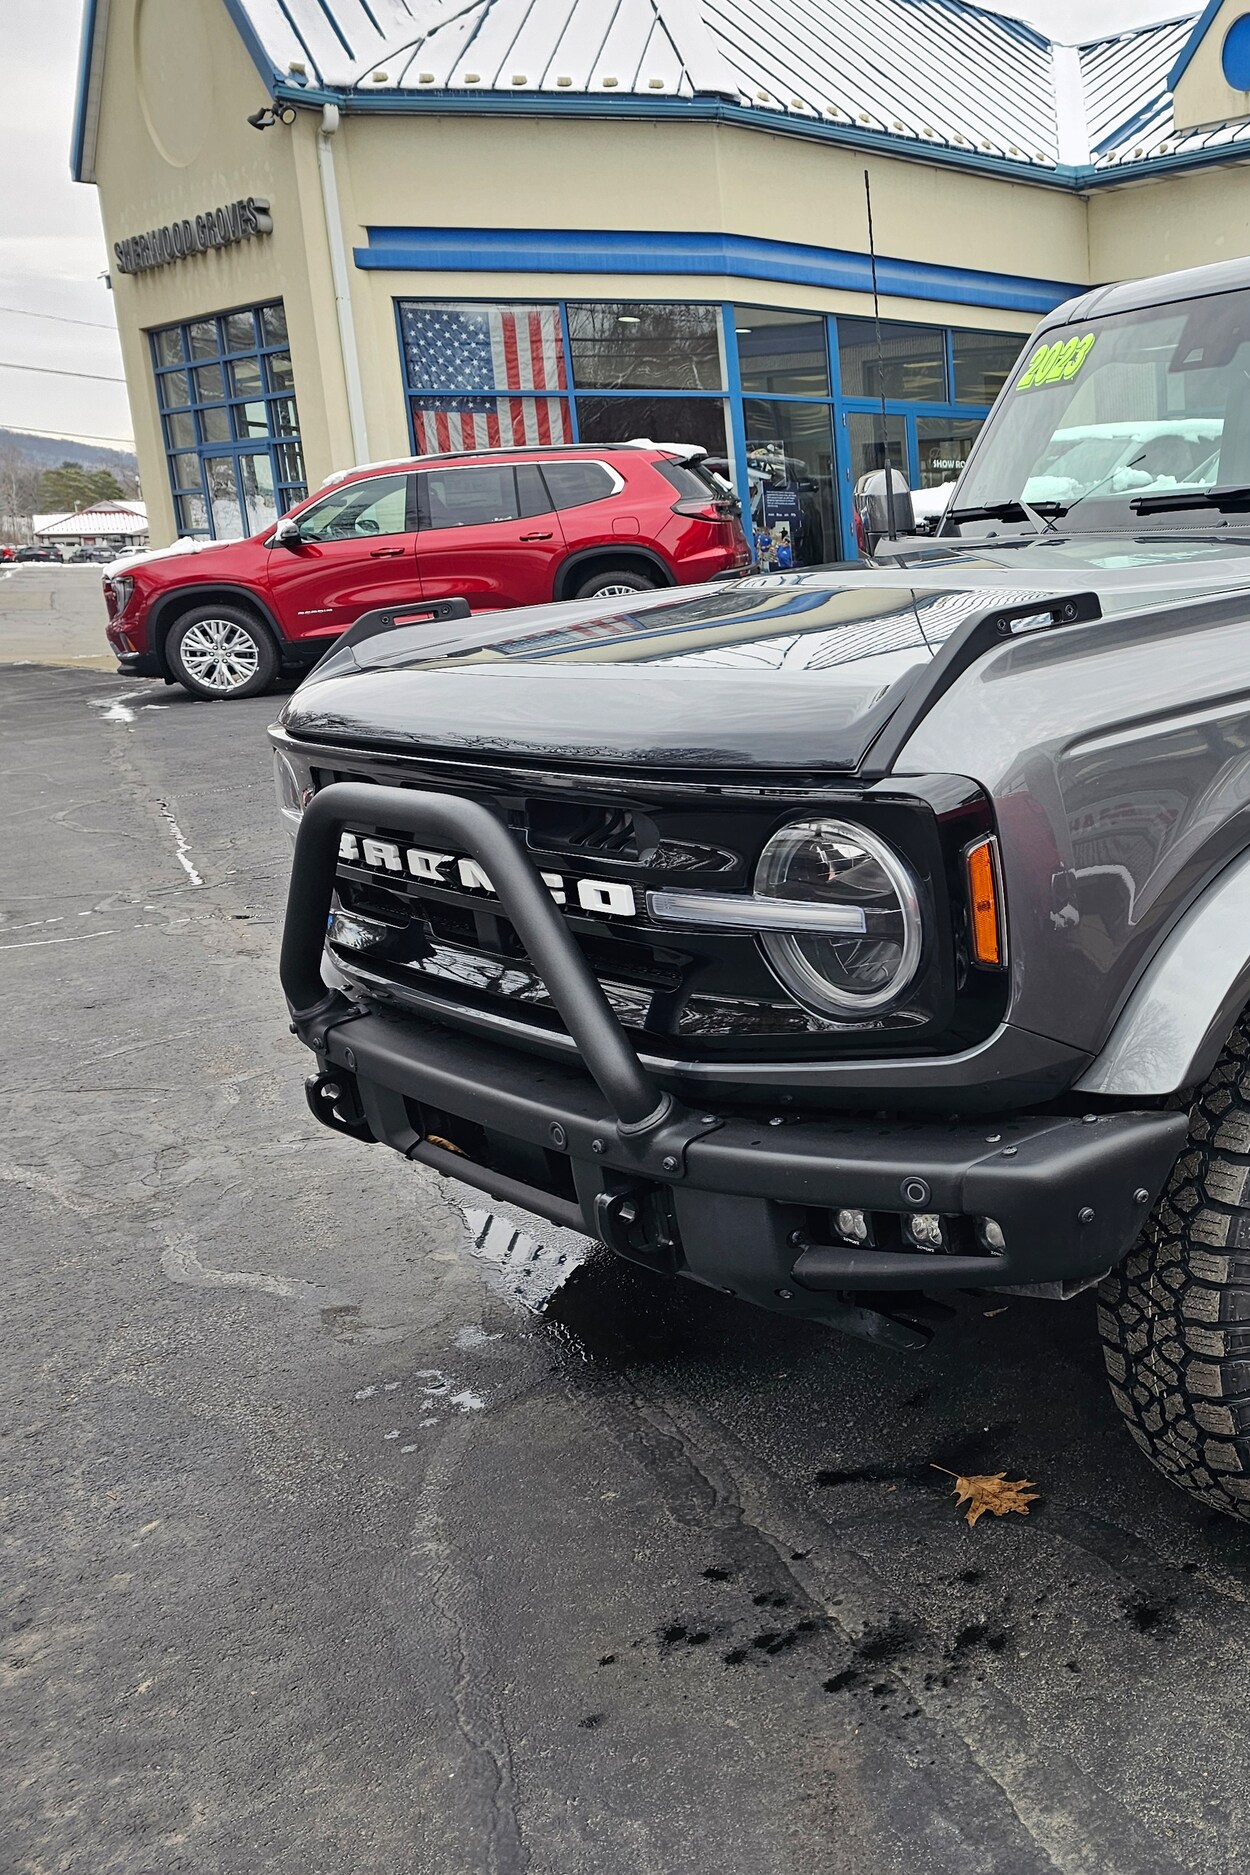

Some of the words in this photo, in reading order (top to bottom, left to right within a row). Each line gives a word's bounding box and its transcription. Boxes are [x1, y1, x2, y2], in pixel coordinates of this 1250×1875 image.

[114, 219, 196, 275] SHERWOOD
[195, 197, 266, 254] GROVES
[1015, 333, 1096, 391] 2023
[933, 460, 955, 469] SHOW
